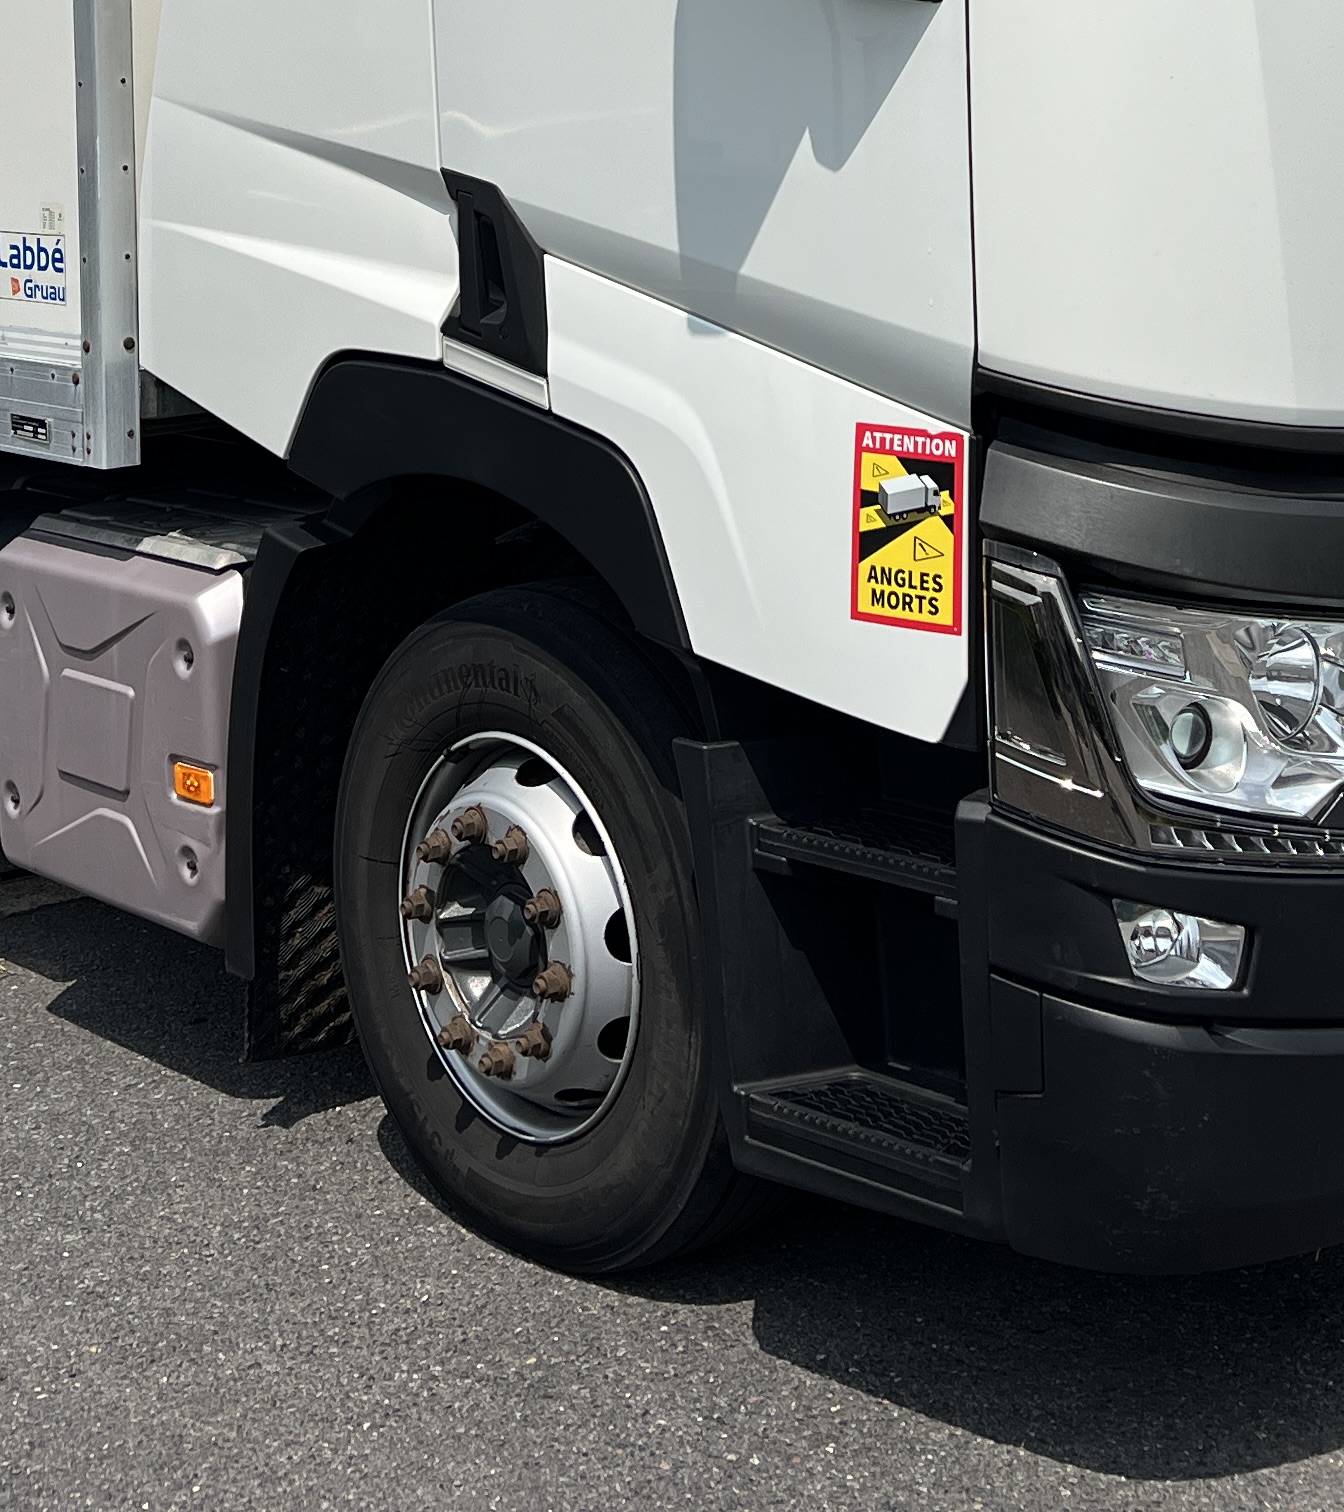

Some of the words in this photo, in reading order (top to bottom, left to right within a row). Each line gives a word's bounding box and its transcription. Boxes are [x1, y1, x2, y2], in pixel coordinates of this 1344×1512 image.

[24, 279, 65, 302] Gruau
[861, 430, 957, 458] ATTENTION
[866, 564, 944, 594] ANGLES
[870, 587, 940, 617] MORTS
